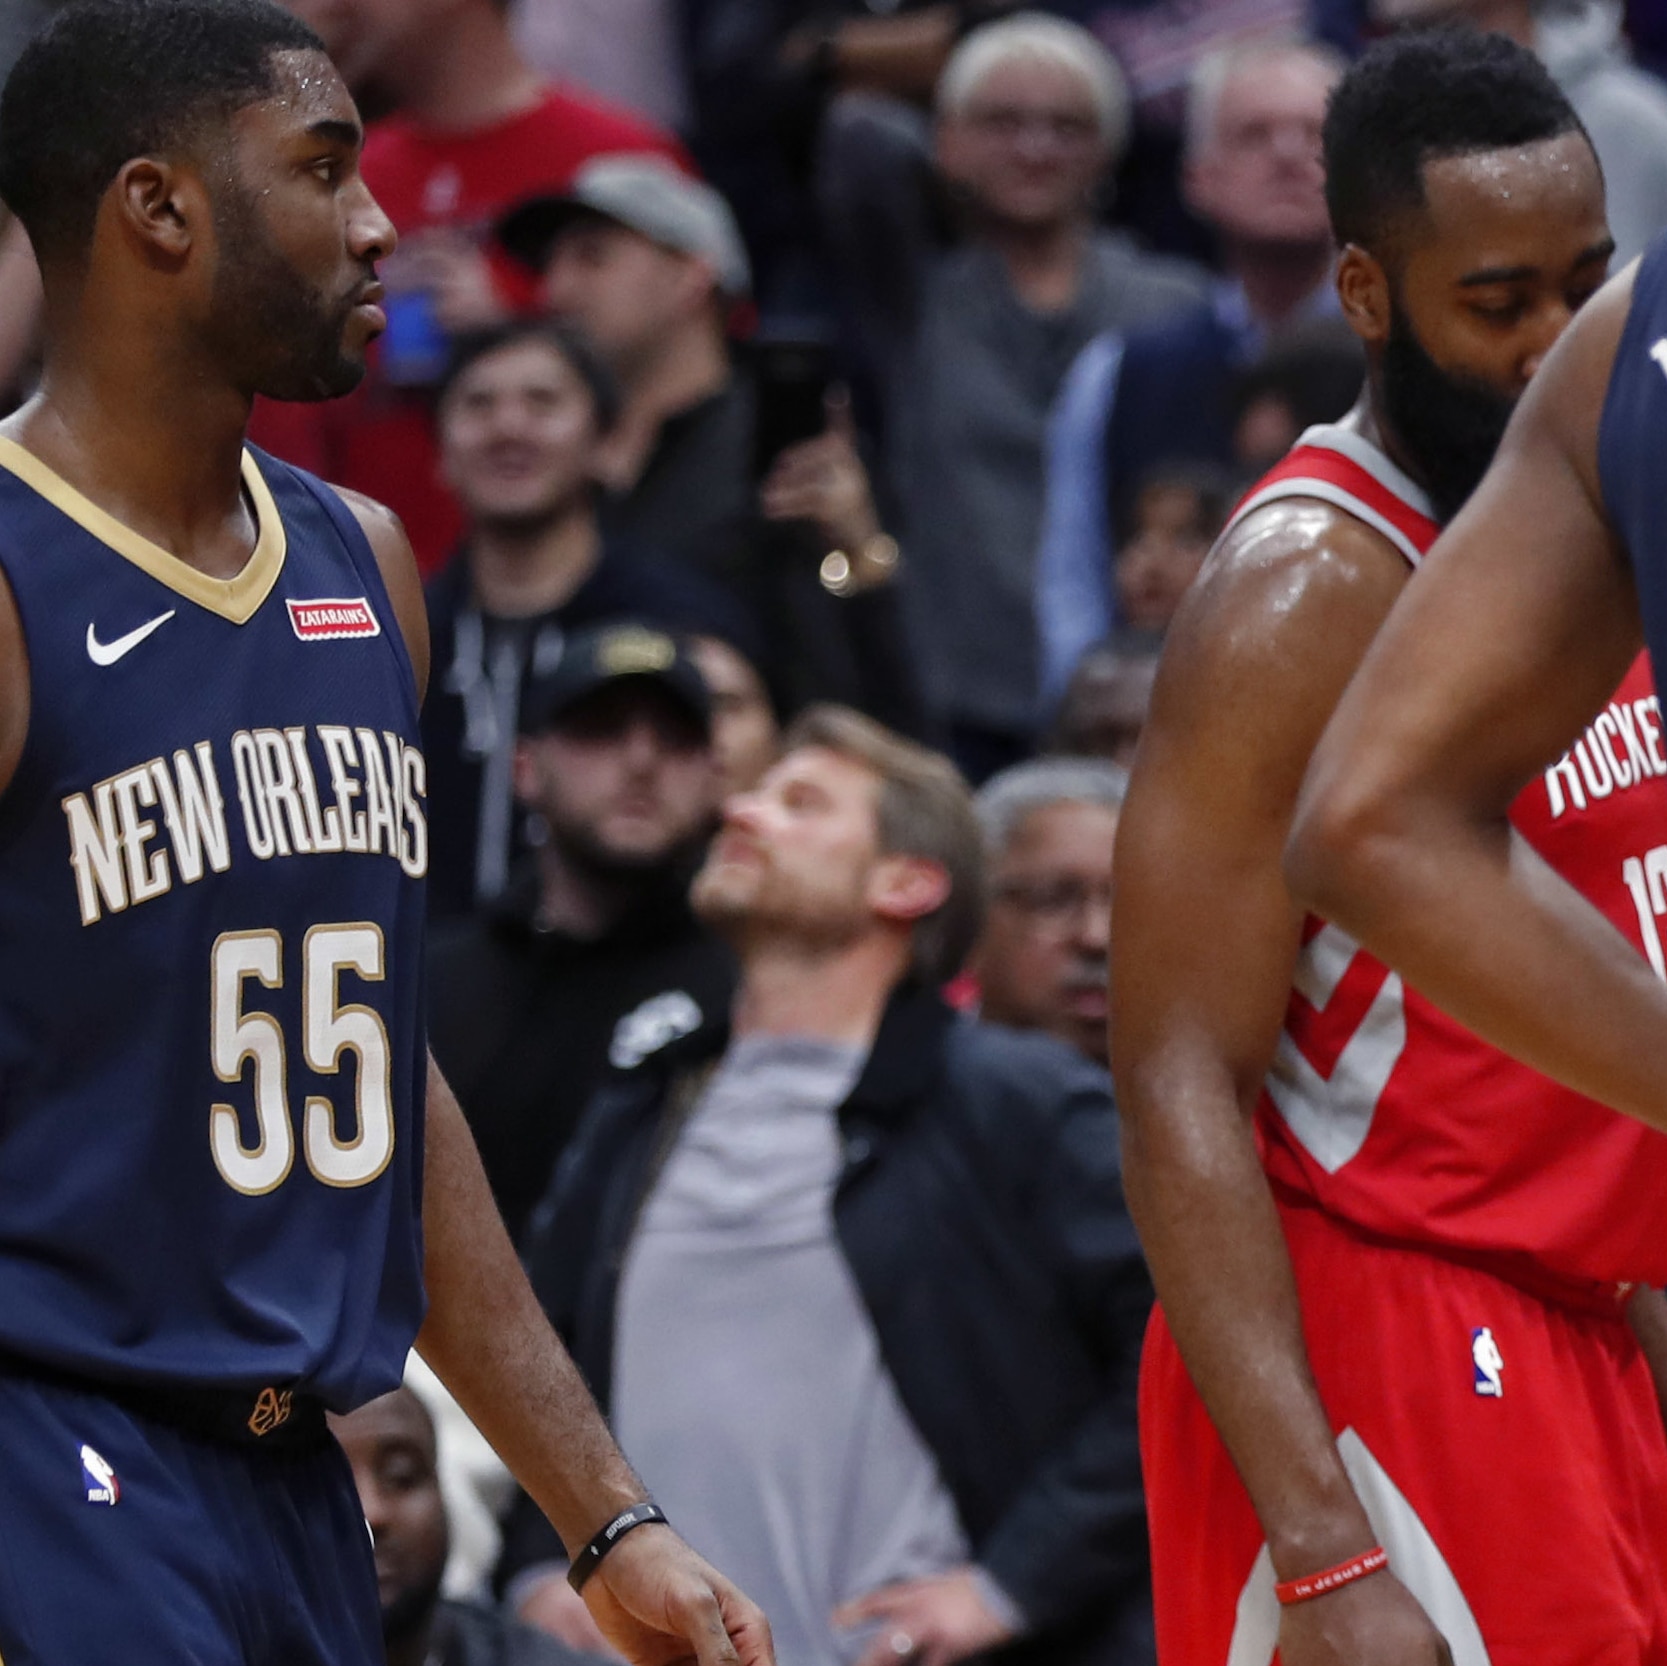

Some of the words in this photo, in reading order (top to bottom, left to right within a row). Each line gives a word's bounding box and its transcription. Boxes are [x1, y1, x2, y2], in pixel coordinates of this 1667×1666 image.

[61, 741, 231, 926] NEW
[231, 725, 427, 878] ORLEANS
[1545, 695, 1667, 818] ROCKE
[209, 921, 395, 1196] 55
